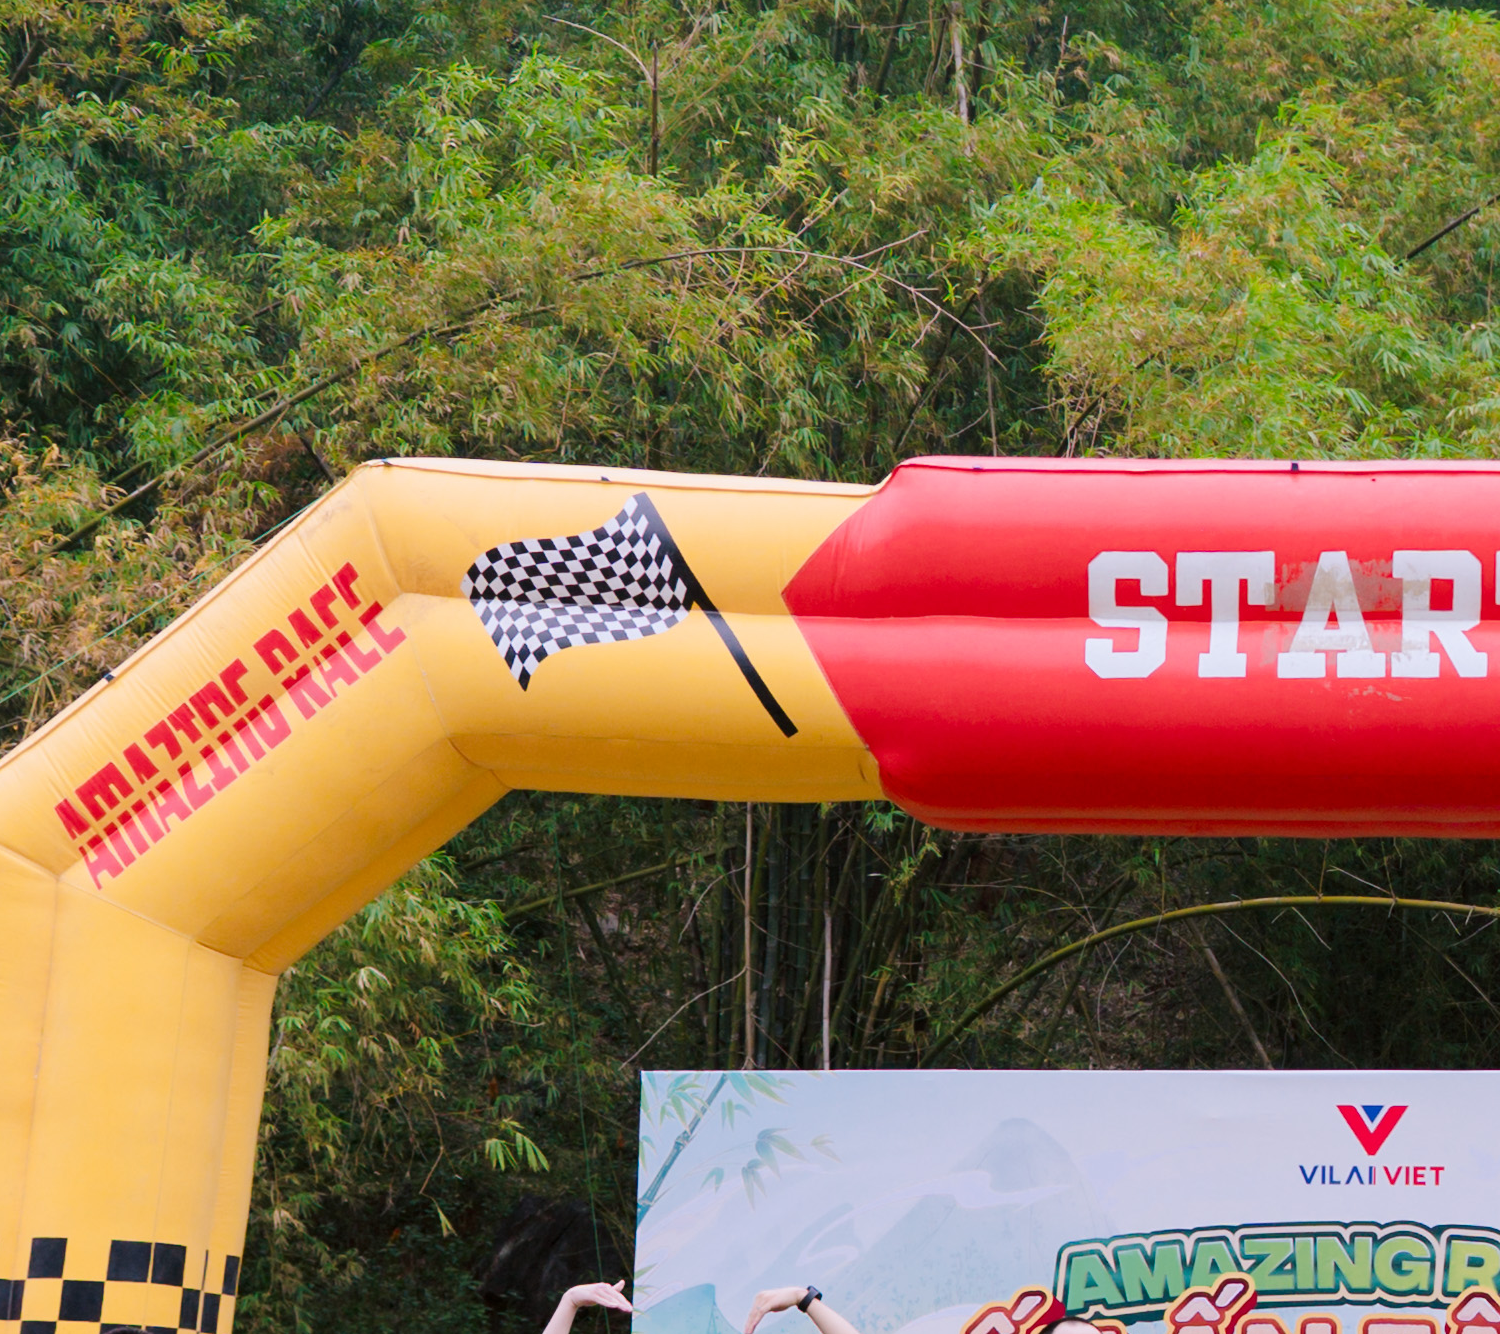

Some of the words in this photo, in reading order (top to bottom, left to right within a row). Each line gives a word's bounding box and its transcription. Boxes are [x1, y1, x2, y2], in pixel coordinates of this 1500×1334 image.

[54, 658, 292, 891] AMAZING
[253, 561, 407, 721] RACE
[1299, 1165, 1376, 1186] VILAI
[1383, 1165, 1445, 1186] VIET
[1065, 1234, 1431, 1311] AMAZING
